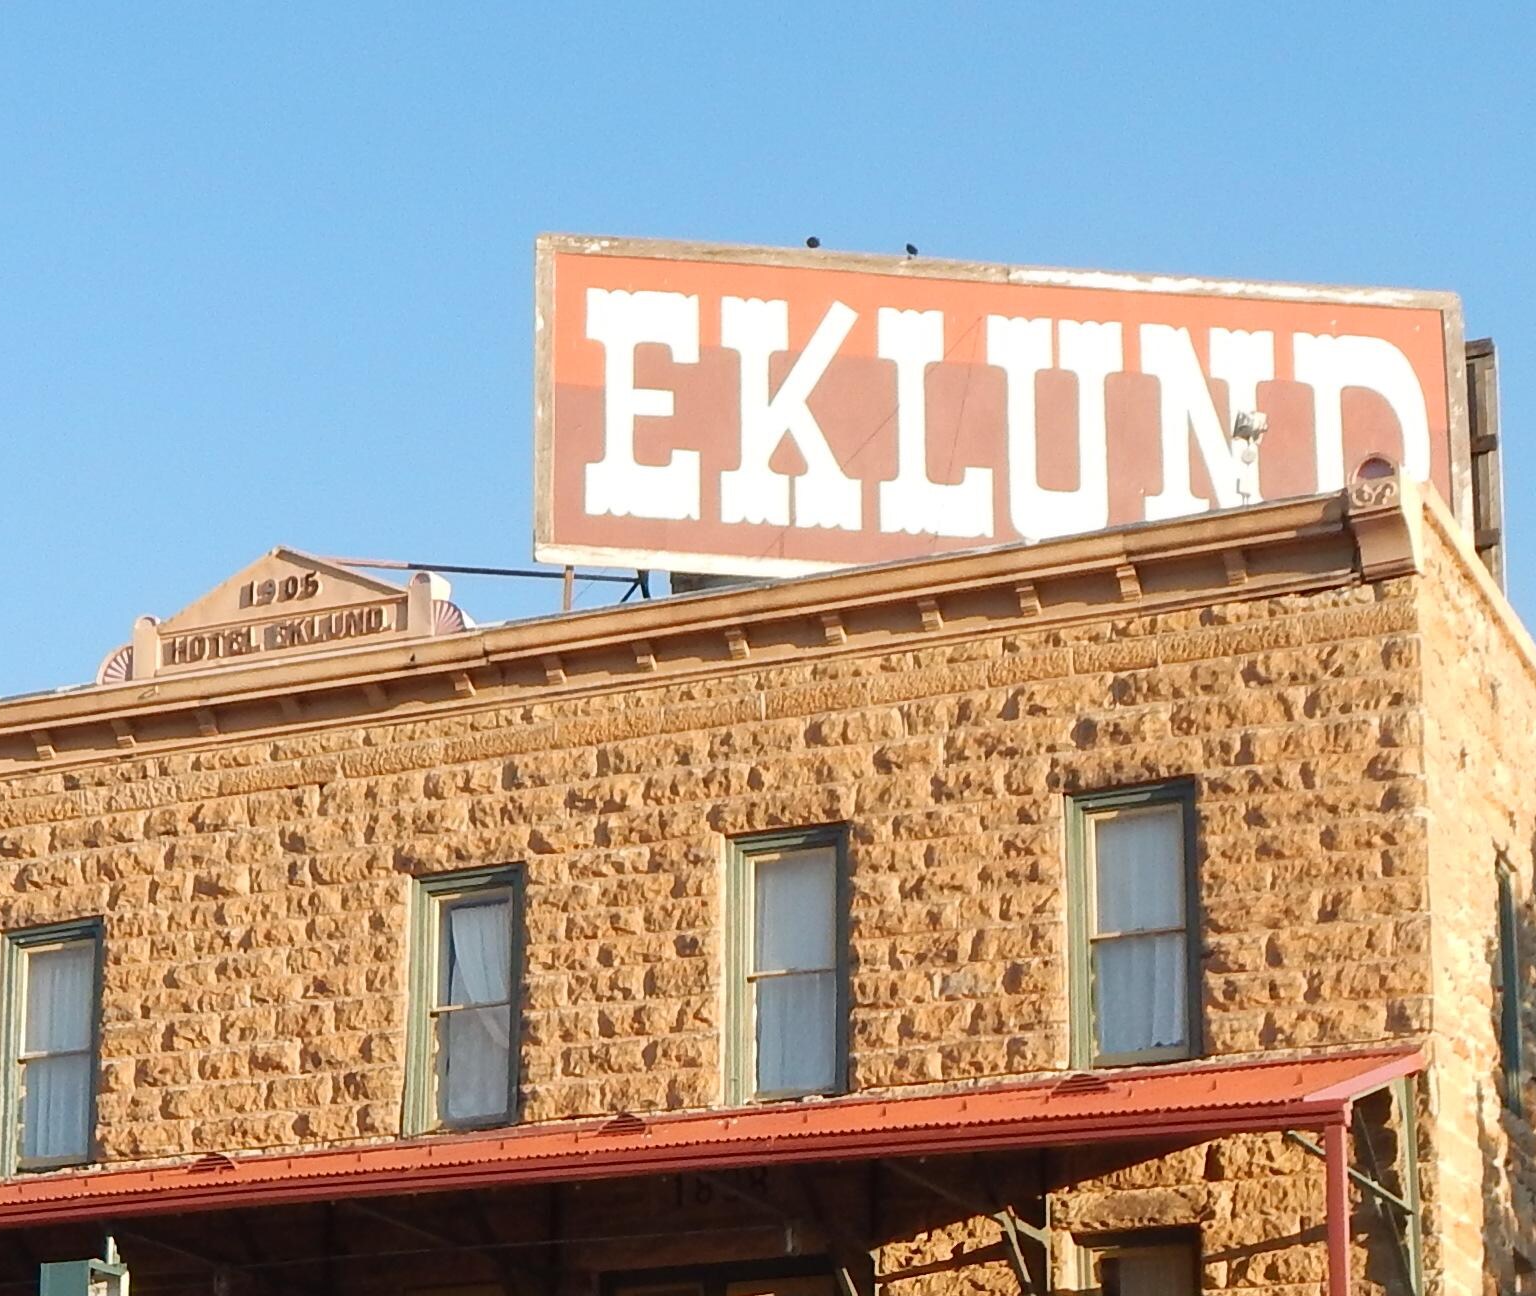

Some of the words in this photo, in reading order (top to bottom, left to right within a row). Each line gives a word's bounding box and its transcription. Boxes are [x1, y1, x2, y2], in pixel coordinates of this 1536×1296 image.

[585, 287, 1432, 544] EKLUND
[239, 570, 323, 609] 1905
[164, 625, 263, 665] HOTEL
